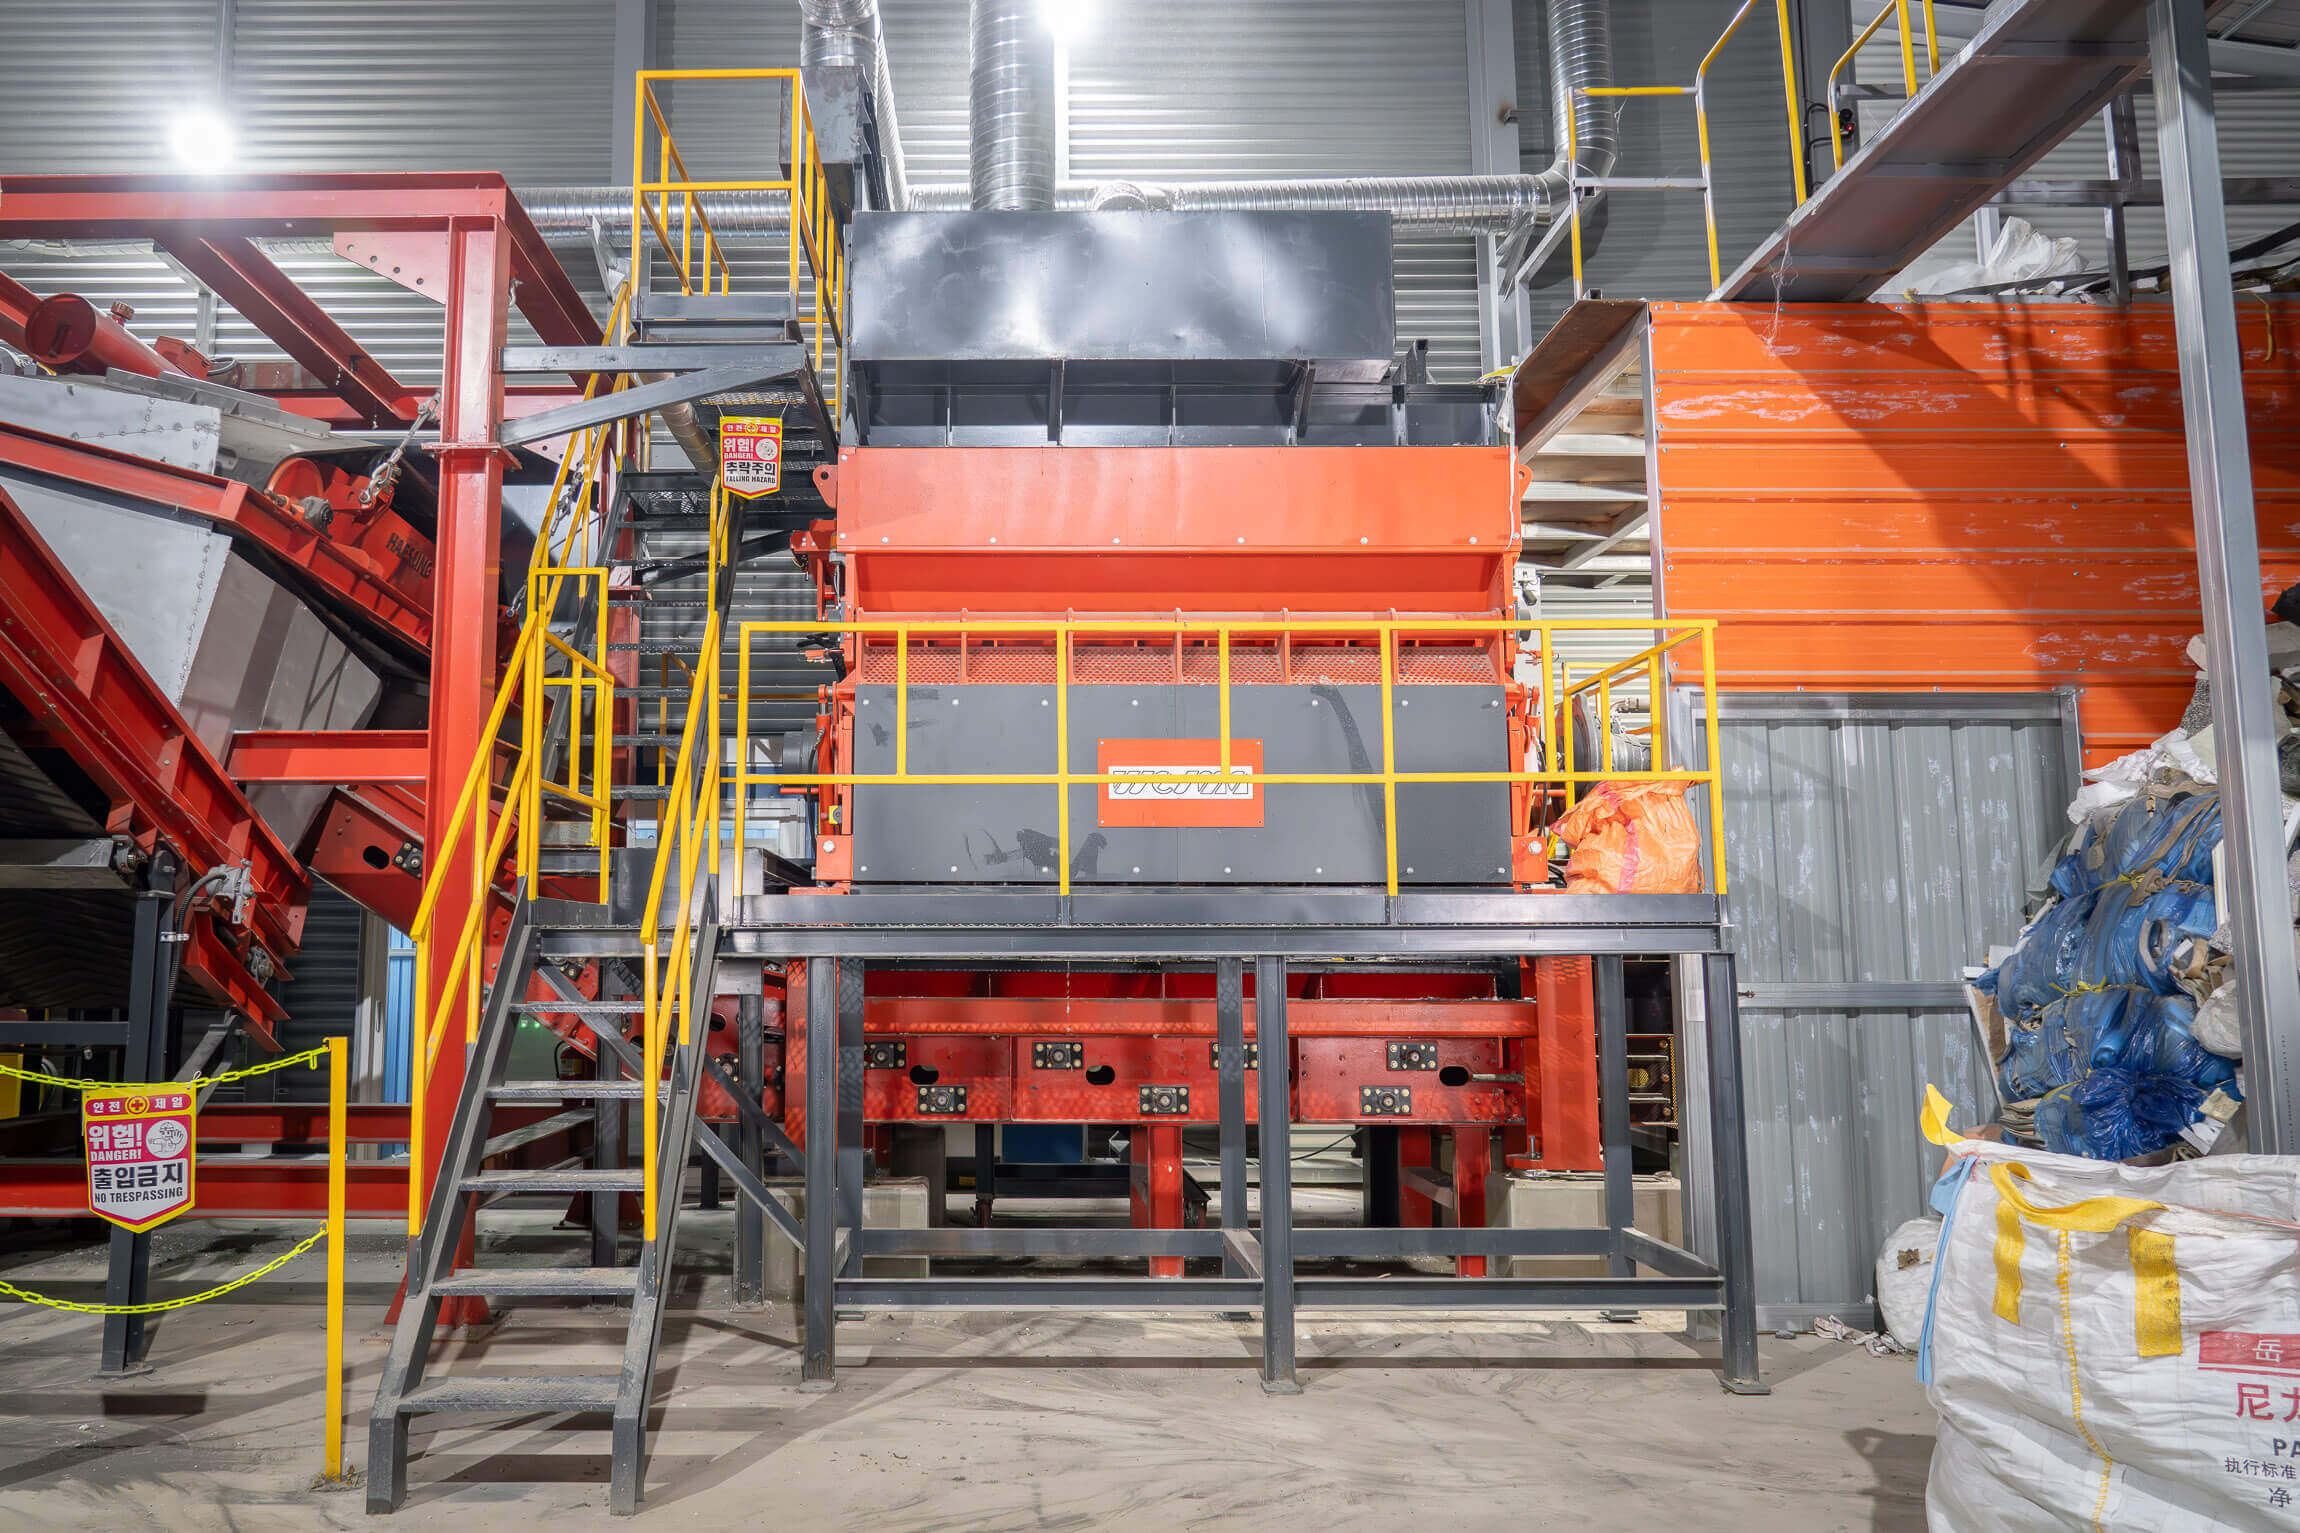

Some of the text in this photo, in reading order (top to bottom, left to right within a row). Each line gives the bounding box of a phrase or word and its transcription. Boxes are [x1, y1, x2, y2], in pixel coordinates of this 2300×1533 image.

[724, 437, 754, 452] 위험!
[726, 461, 776, 476] 추락주의
[751, 476, 776, 484] HAZARD
[92, 1096, 183, 1114] 안전 제일
[88, 1122, 143, 1150] 위험!
[90, 1148, 142, 1162] DANGER!
[94, 1162, 184, 1190] 출입금지
[94, 1187, 183, 1204] NO TRESPASSING
[2224, 1456, 2297, 1480] 执行标准
[2268, 1487, 2293, 1508] 净
